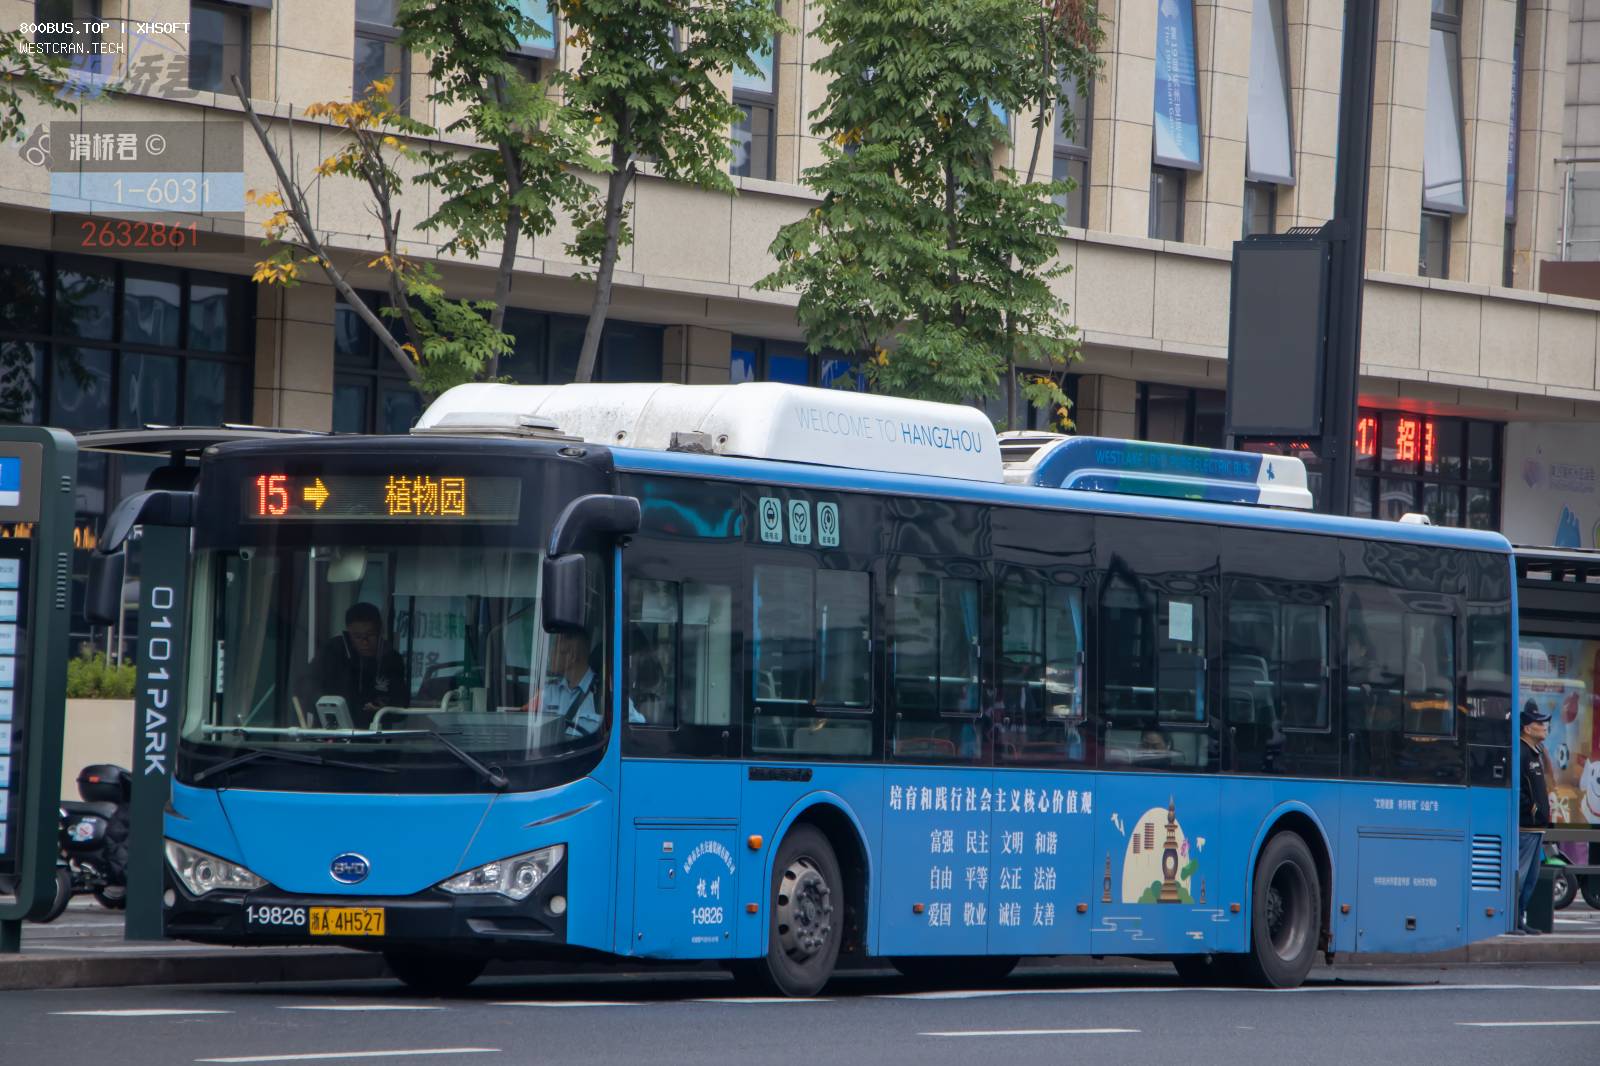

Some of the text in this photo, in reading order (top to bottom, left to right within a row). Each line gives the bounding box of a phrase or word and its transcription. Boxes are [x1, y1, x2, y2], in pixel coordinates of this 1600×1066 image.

[795, 407, 982, 453] WELCOME TO HANGZHOU
[256, 475, 289, 515] 15
[384, 475, 466, 516] 植物园
[890, 785, 1093, 815] 培育和践行社会主义核心价值观
[930, 829, 1058, 855] 富强 民主 文明 和谐
[930, 865, 1056, 891] 自由 平等 公正 法治
[246, 905, 306, 926] 1-9826
[691, 907, 723, 925] 1-9826
[928, 902, 1055, 927] 爱国 敬业 诚信 友善
